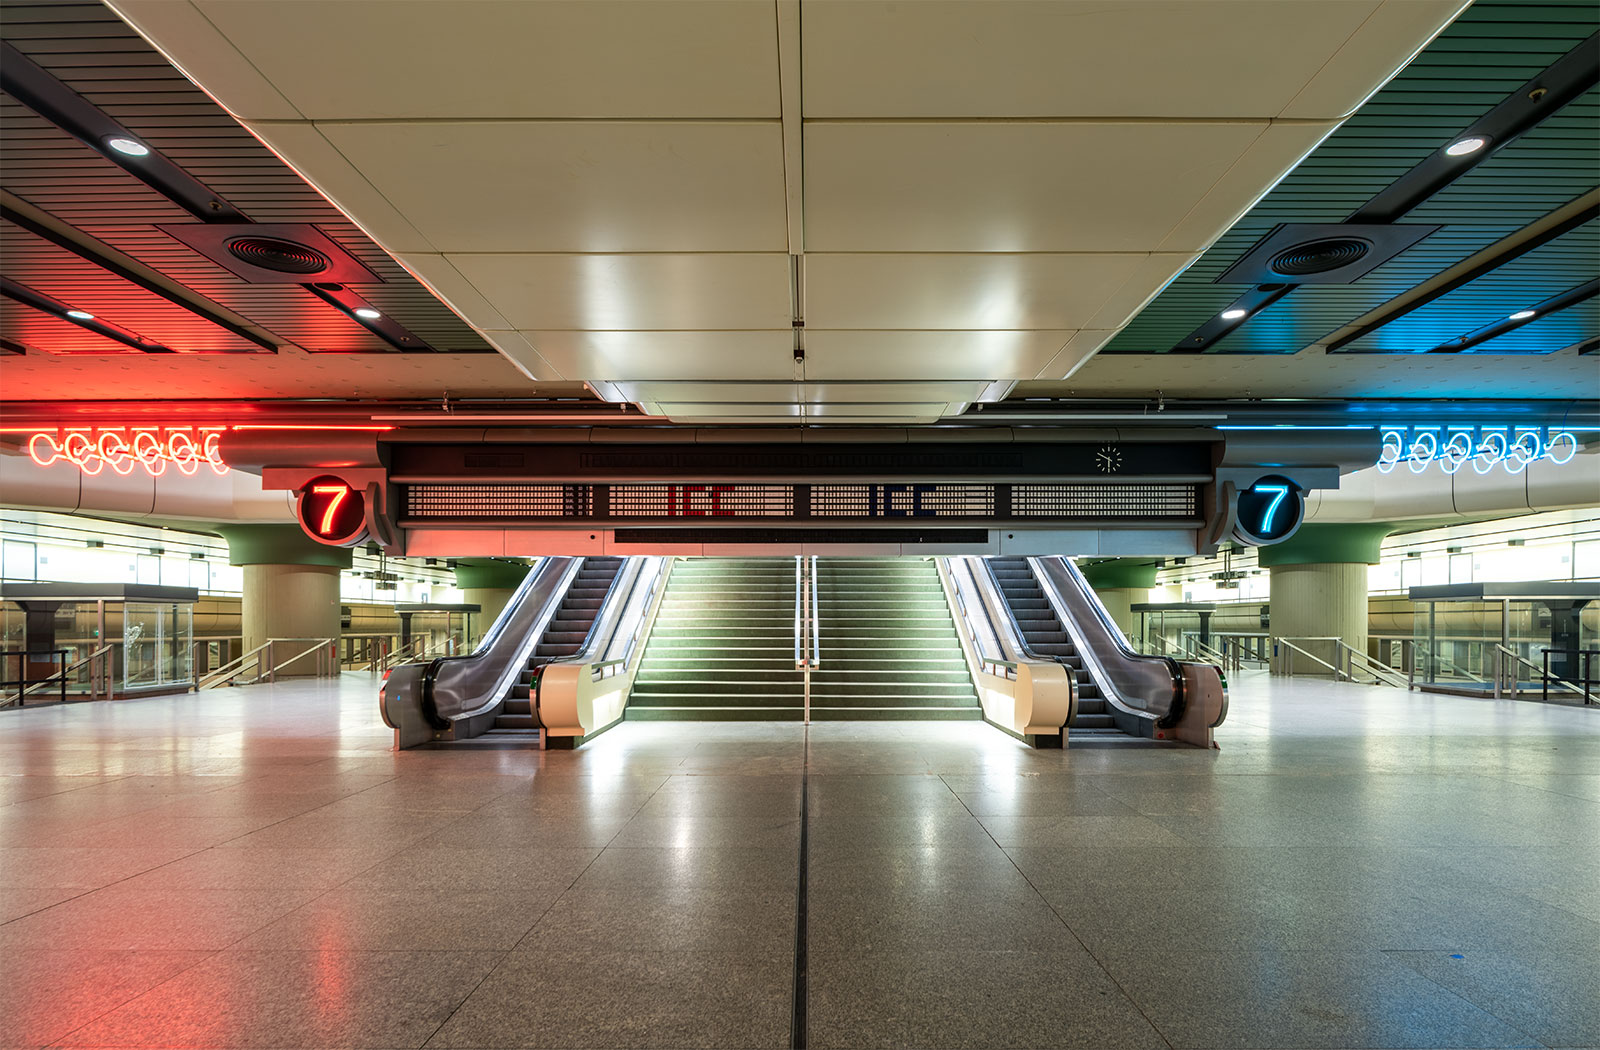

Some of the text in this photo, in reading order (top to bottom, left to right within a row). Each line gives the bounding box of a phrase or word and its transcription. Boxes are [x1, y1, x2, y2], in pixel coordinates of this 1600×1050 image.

[312, 485, 348, 535] 7
[668, 485, 735, 516] ICC
[869, 485, 936, 516] ICC
[1254, 484, 1289, 534] 7
